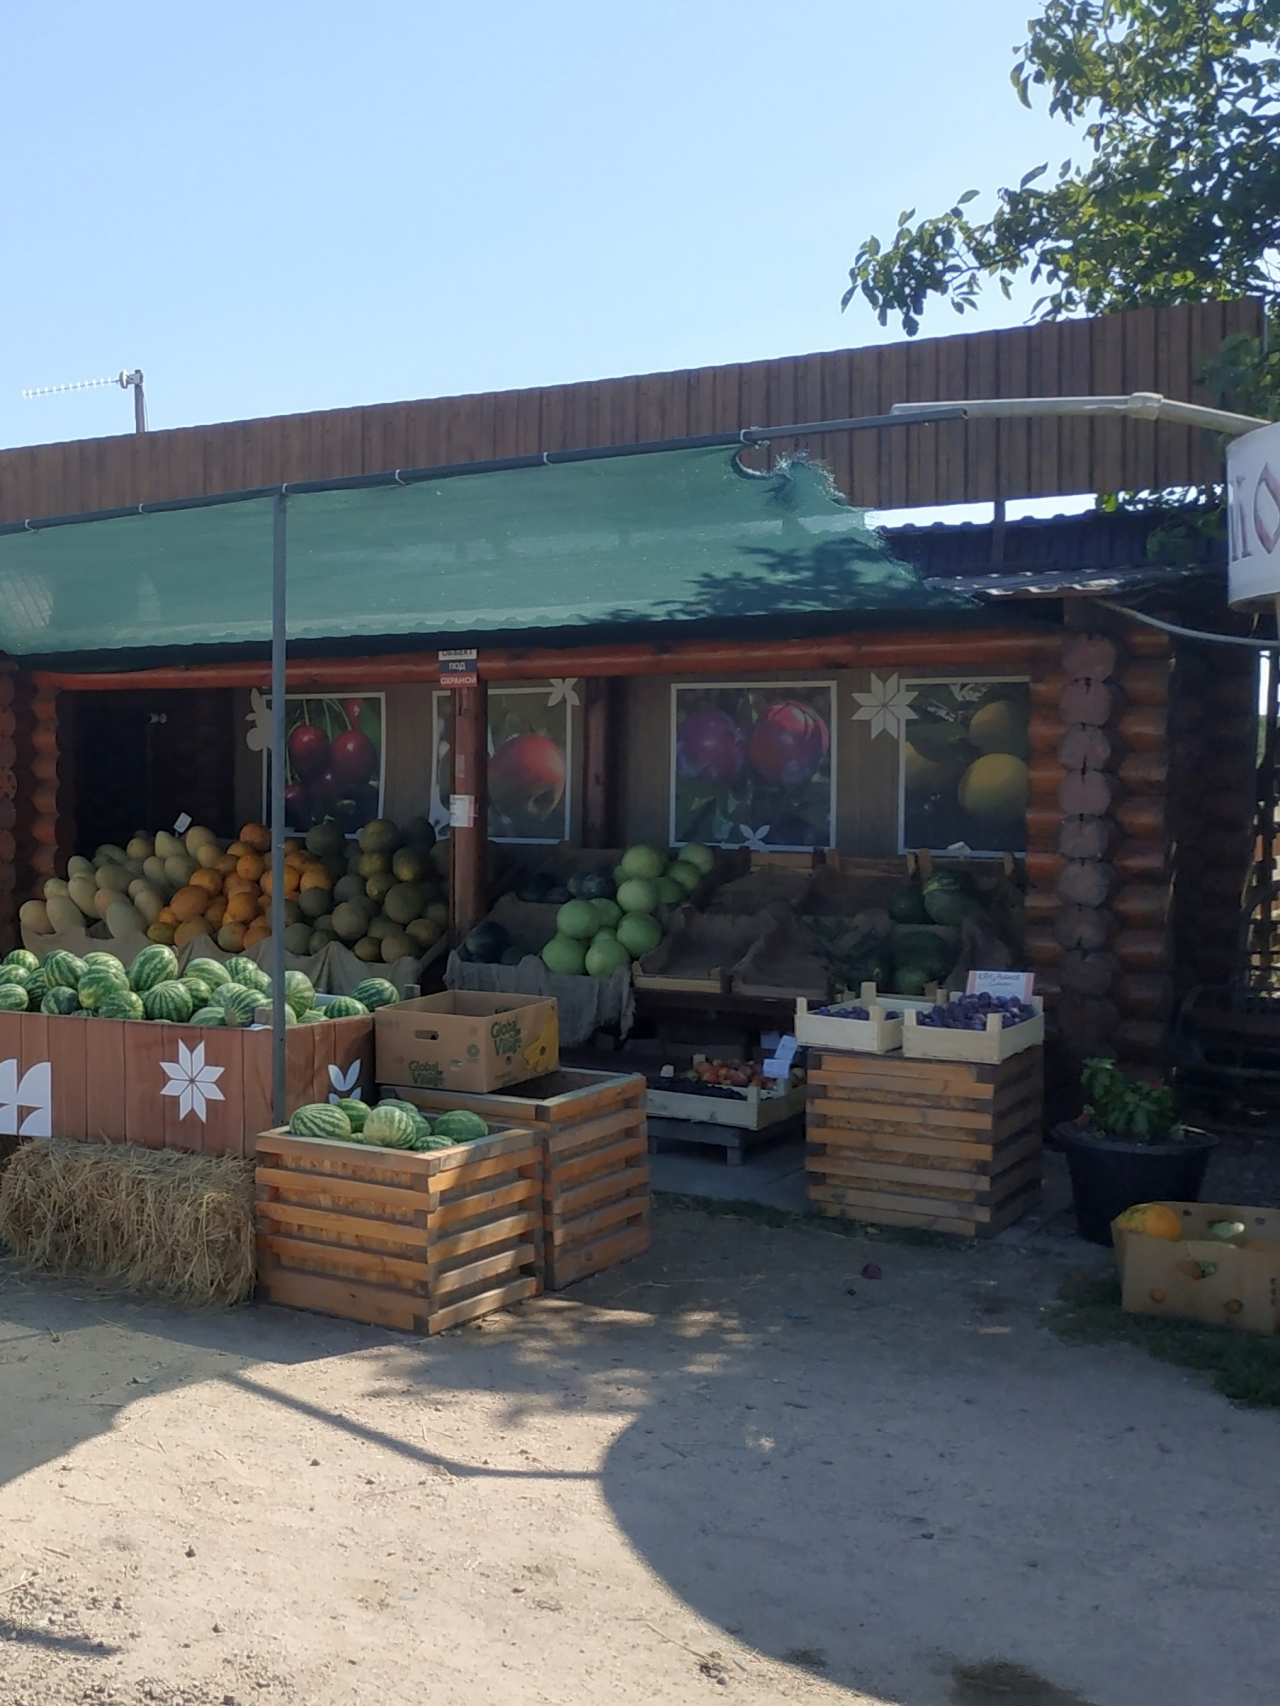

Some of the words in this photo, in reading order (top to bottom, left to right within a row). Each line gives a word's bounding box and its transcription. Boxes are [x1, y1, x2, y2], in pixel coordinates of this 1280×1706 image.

[448, 662, 466, 671] ПОД
[440, 675, 477, 685] ОХРАНОЙ
[491, 1017, 518, 1038] Global
[409, 1061, 439, 1072] Global
